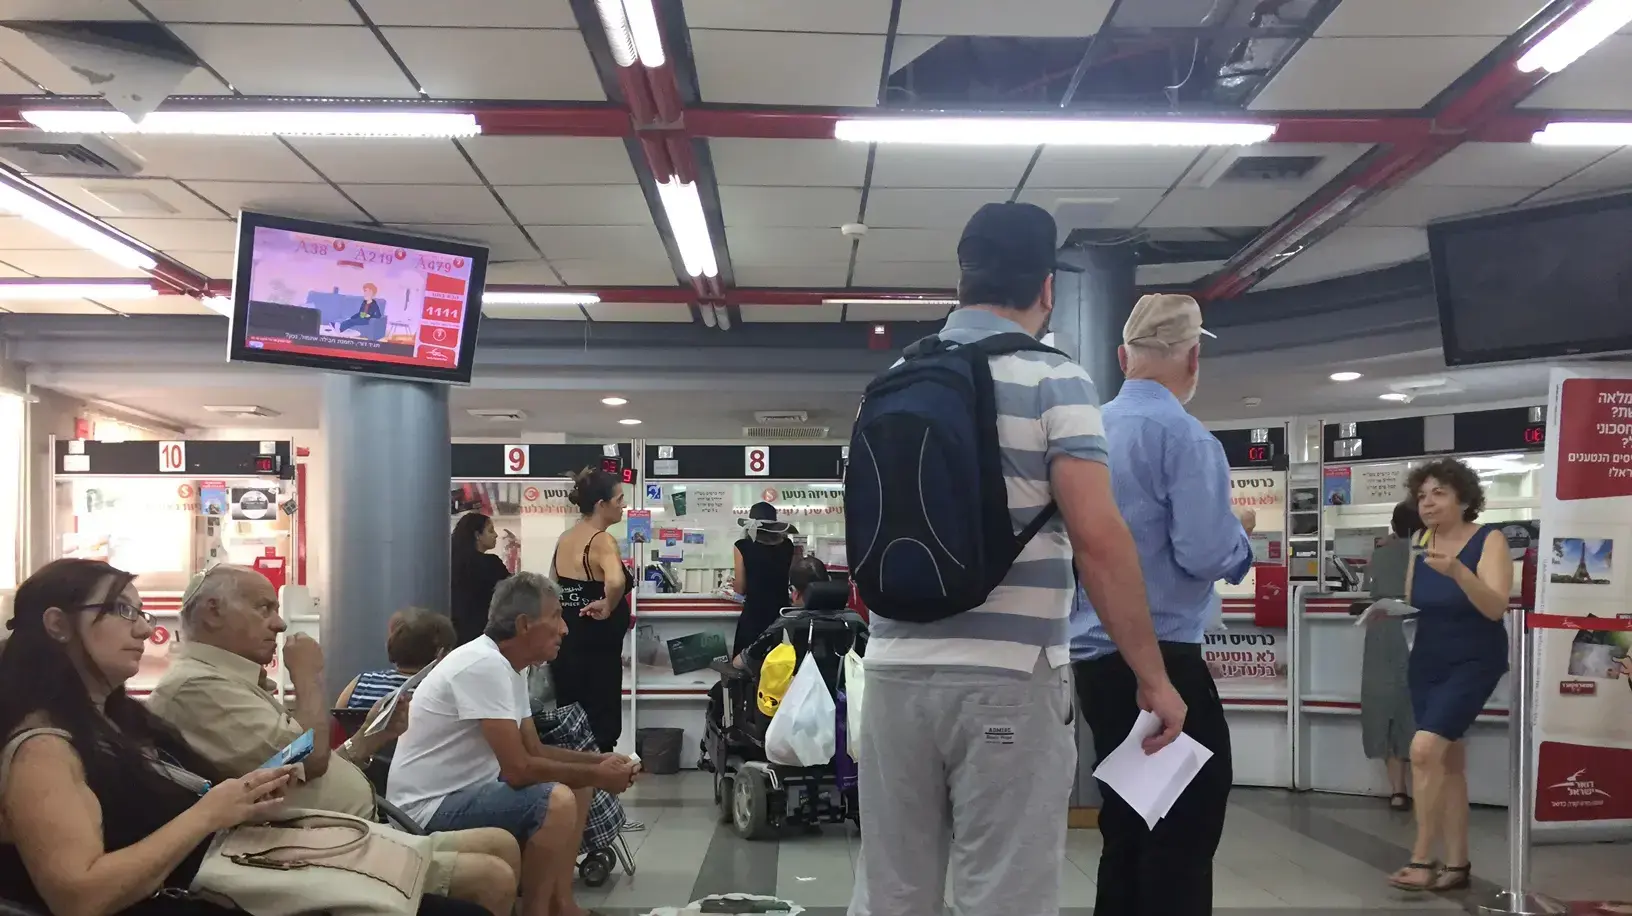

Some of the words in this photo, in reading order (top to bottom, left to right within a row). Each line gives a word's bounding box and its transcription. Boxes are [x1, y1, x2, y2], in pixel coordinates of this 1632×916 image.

[296, 240, 328, 256] A38
[354, 247, 393, 264] A219
[162, 444, 182, 469] 10
[508, 447, 525, 472] 9
[749, 449, 765, 472] 8
[1568, 452, 1610, 463] הנטענים
[623, 469, 632, 482] 9
[1237, 478, 1275, 488] כרטיס
[782, 490, 807, 500] נטען
[808, 490, 828, 499] ויזה
[1231, 497, 1257, 506] נוסע
[1230, 634, 1275, 645] כרטיס
[1205, 651, 1253, 662] נוסעים
[1256, 650, 1275, 662] לא
[1575, 780, 1595, 789] דואר
[1567, 787, 1595, 796] ישראל
